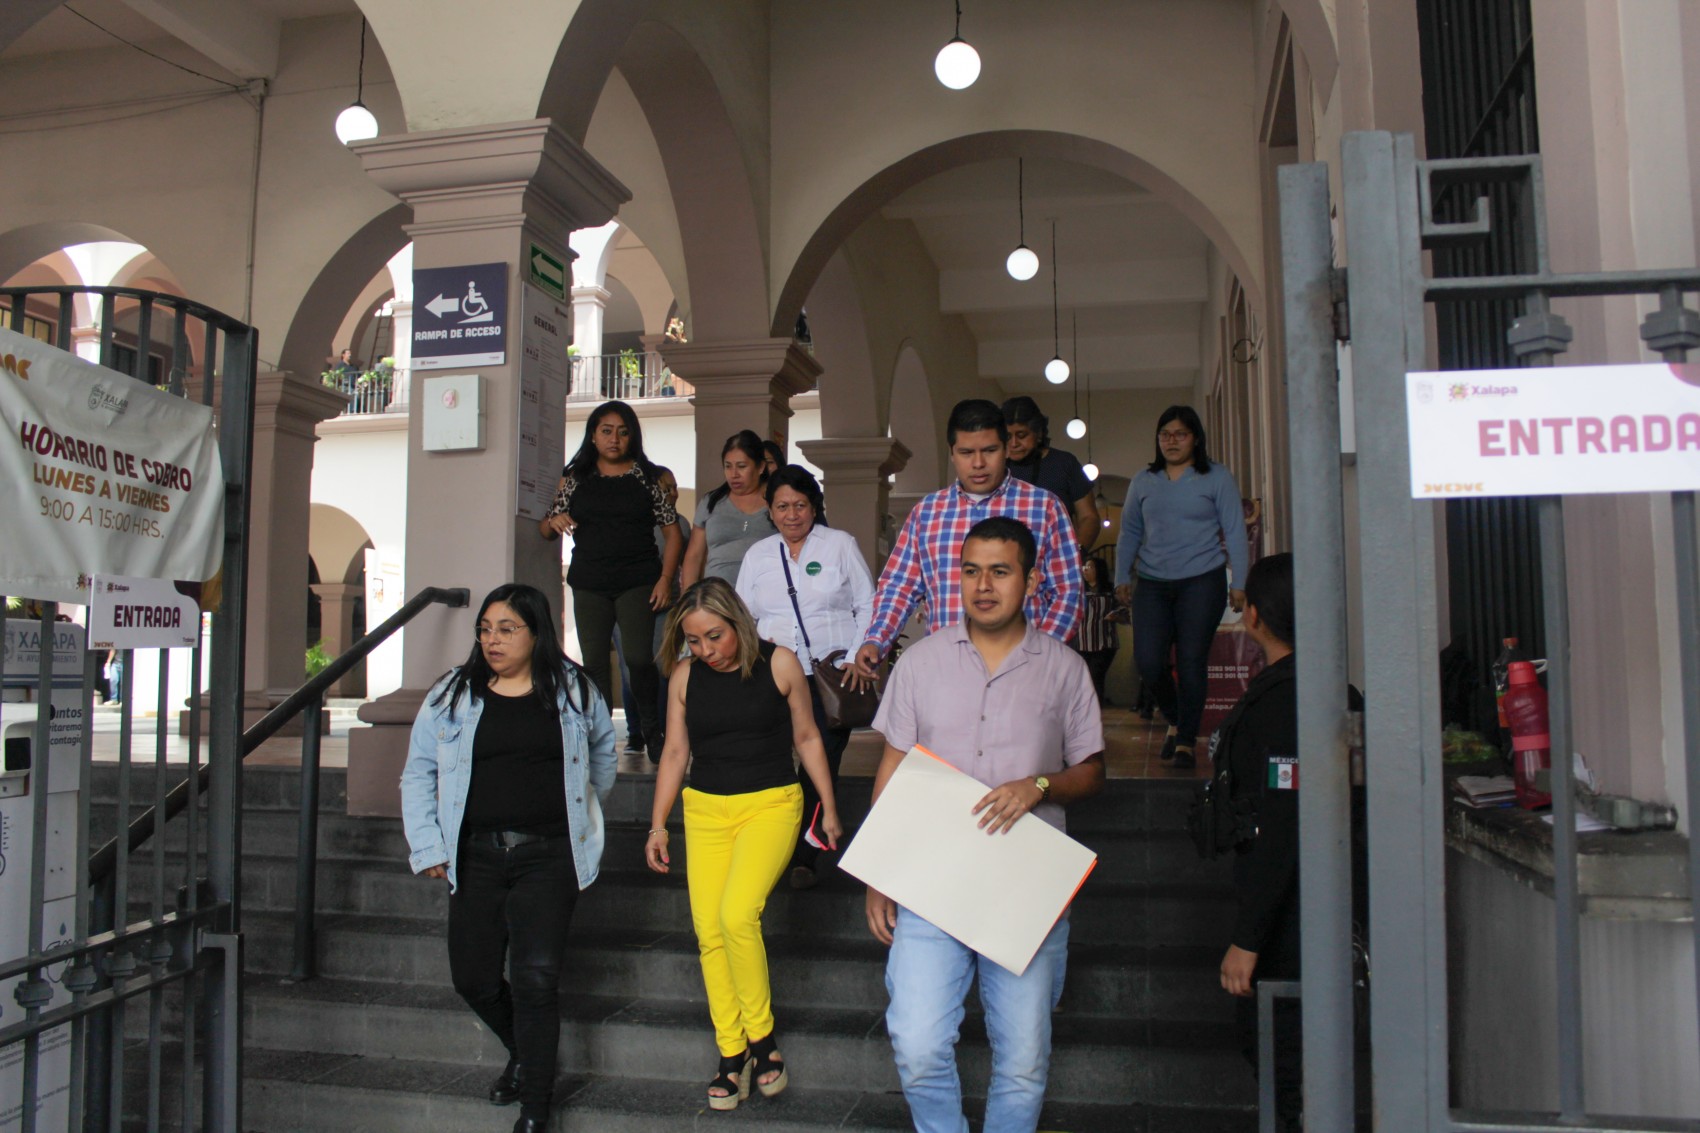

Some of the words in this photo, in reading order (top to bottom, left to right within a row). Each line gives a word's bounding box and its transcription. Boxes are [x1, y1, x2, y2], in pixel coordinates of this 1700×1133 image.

[414, 330, 448, 341] RAMPA
[450, 328, 463, 339] DE
[465, 325, 502, 338] ACCESO
[533, 315, 558, 337] GENERAL
[1471, 384, 1518, 397] Xalapa
[1478, 412, 1700, 458] ENTRADA
[20, 421, 108, 472] HORARIO
[113, 449, 139, 479] DE
[141, 458, 193, 493] COBRO
[33, 462, 96, 495] LUNES
[98, 479, 112, 499] A
[116, 482, 171, 513] VIERNES
[40, 496, 75, 522] 9:00
[78, 505, 94, 526] A
[98, 508, 131, 533] 15:00
[132, 519, 165, 539] HRS.
[113, 604, 181, 628] ENTRADA
[18, 631, 77, 650] XAAPA
